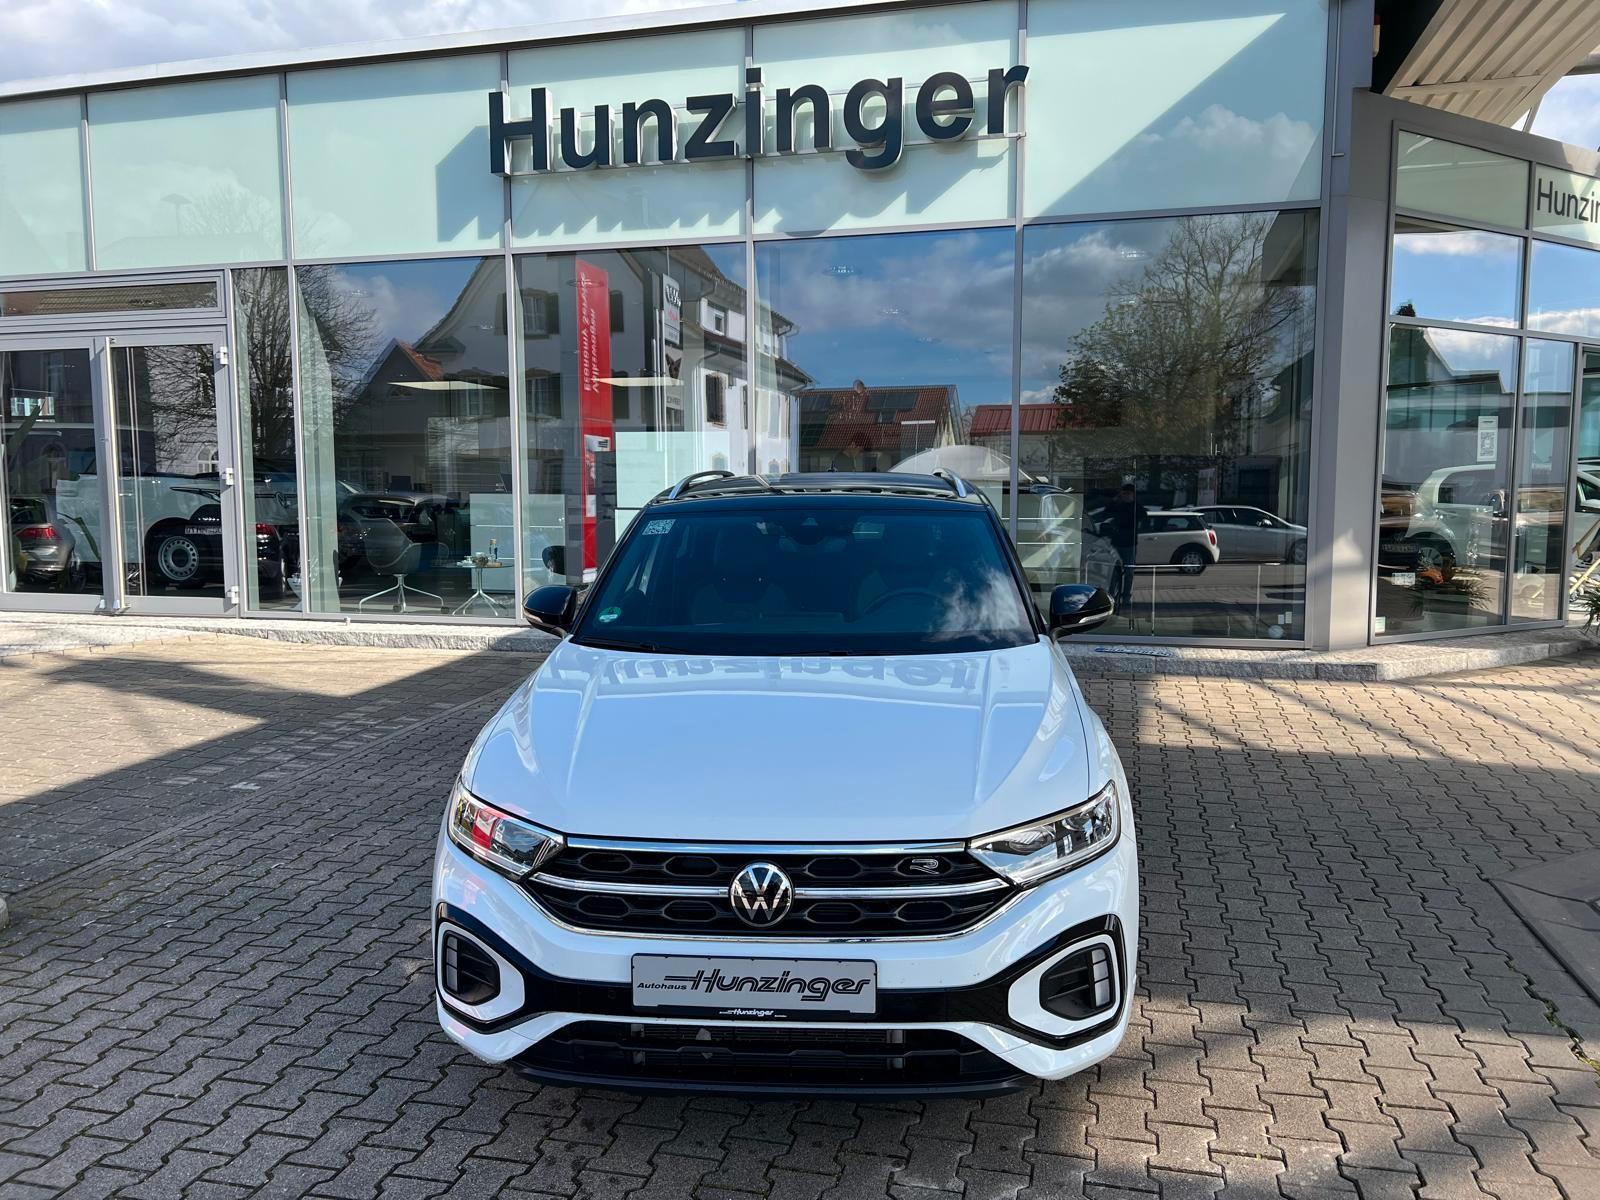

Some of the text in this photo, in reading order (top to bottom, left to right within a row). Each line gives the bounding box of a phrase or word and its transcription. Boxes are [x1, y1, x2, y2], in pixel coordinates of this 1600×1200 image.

[489, 64, 1029, 176] Hunzinger
[637, 968, 871, 1002] Autohaus Hunzinger
[726, 1008, 775, 1017] Hunzinger
